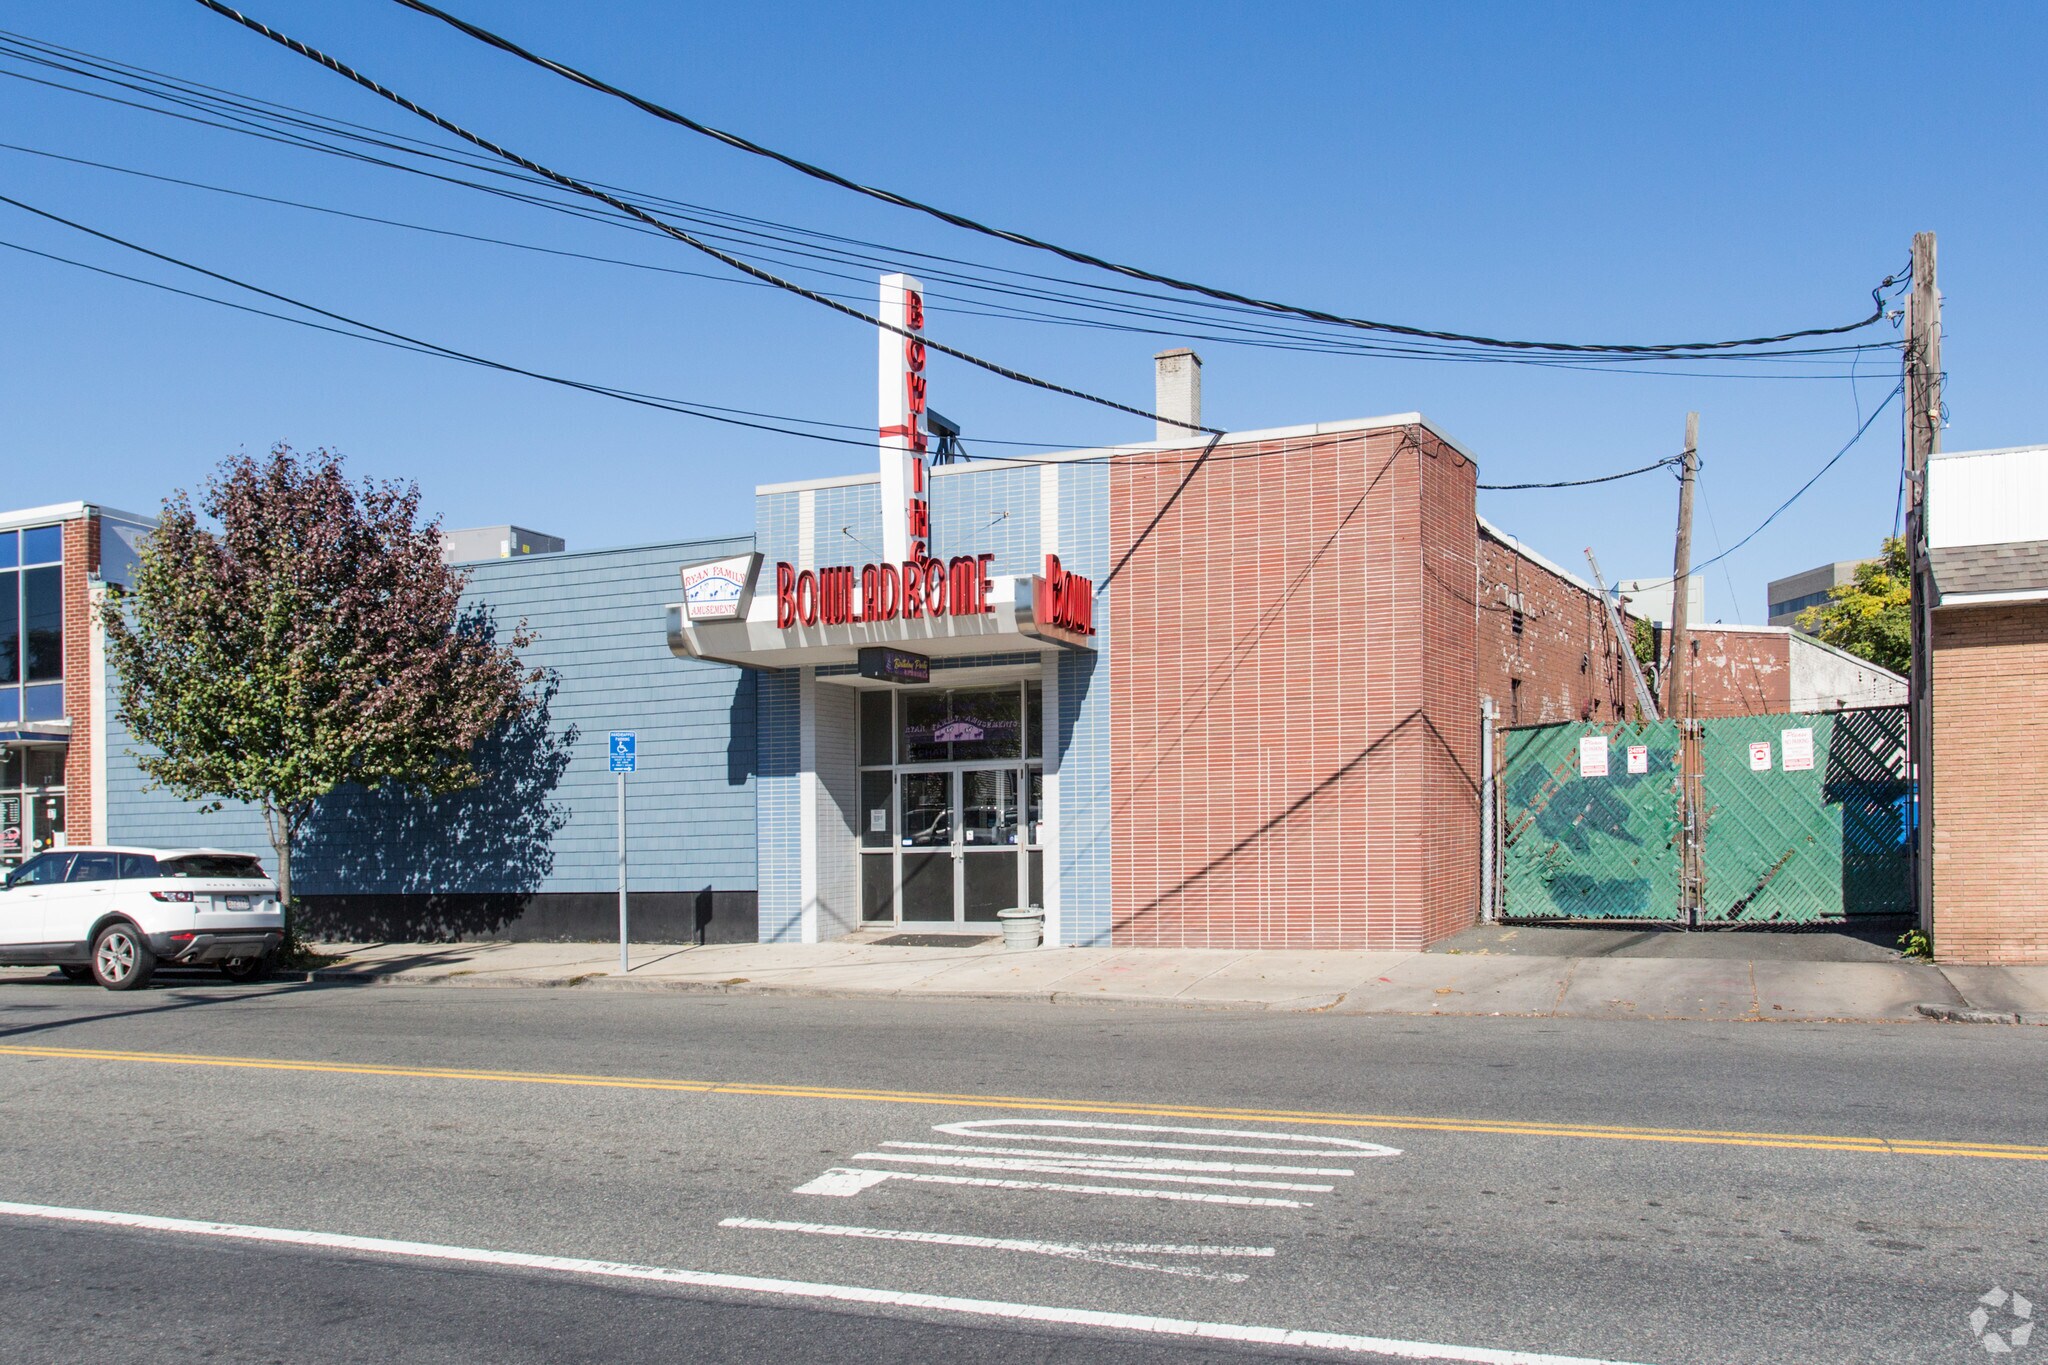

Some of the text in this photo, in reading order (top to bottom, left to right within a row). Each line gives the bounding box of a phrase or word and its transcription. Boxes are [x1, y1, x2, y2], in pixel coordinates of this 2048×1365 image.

[905, 289, 929, 571] BOWLING
[685, 566, 746, 587] RYAN FAMILY
[691, 604, 736, 615] AMUSEMENTS
[776, 553, 996, 629] BOWLADROME
[1045, 553, 1096, 637] BOWL
[43, 775, 53, 785] 17
[717, 1118, 1405, 1283] ONLY
